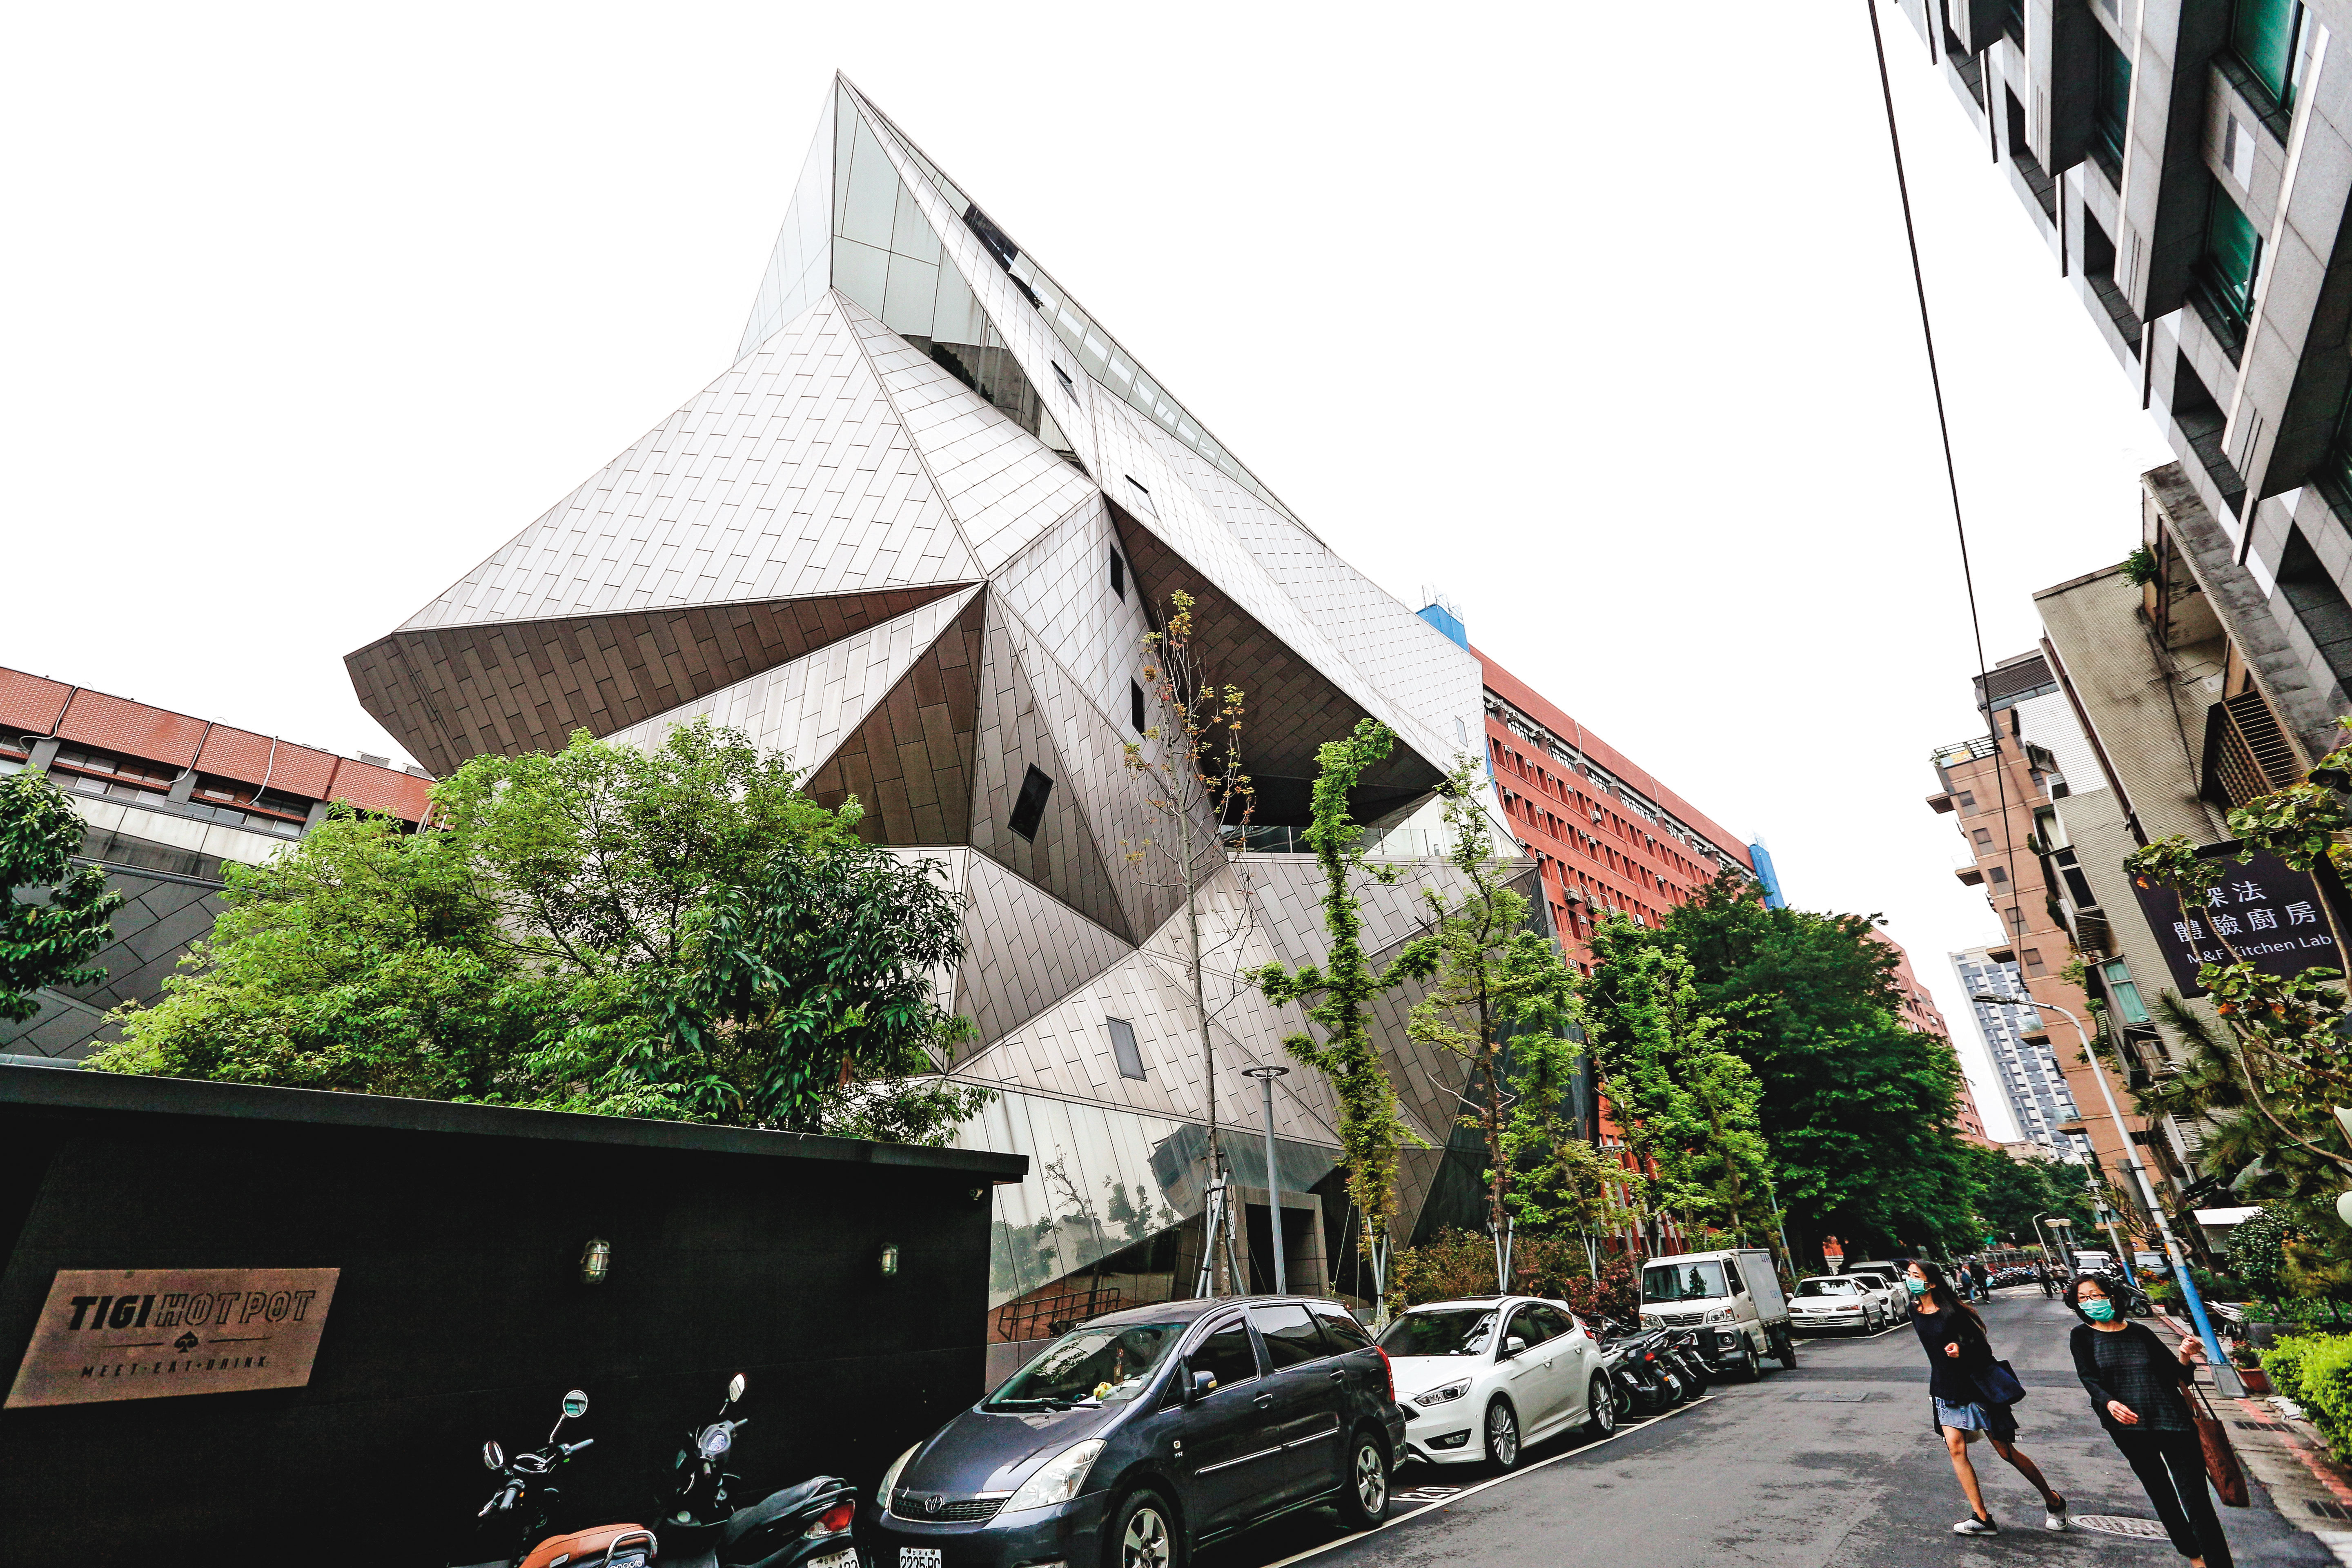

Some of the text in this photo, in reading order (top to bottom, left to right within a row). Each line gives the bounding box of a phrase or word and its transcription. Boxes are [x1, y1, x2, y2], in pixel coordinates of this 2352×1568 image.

[2173, 901, 2316, 942] 體驗廚房
[2299, 934, 2332, 947] Lab
[69, 1294, 157, 1330] TIGI
